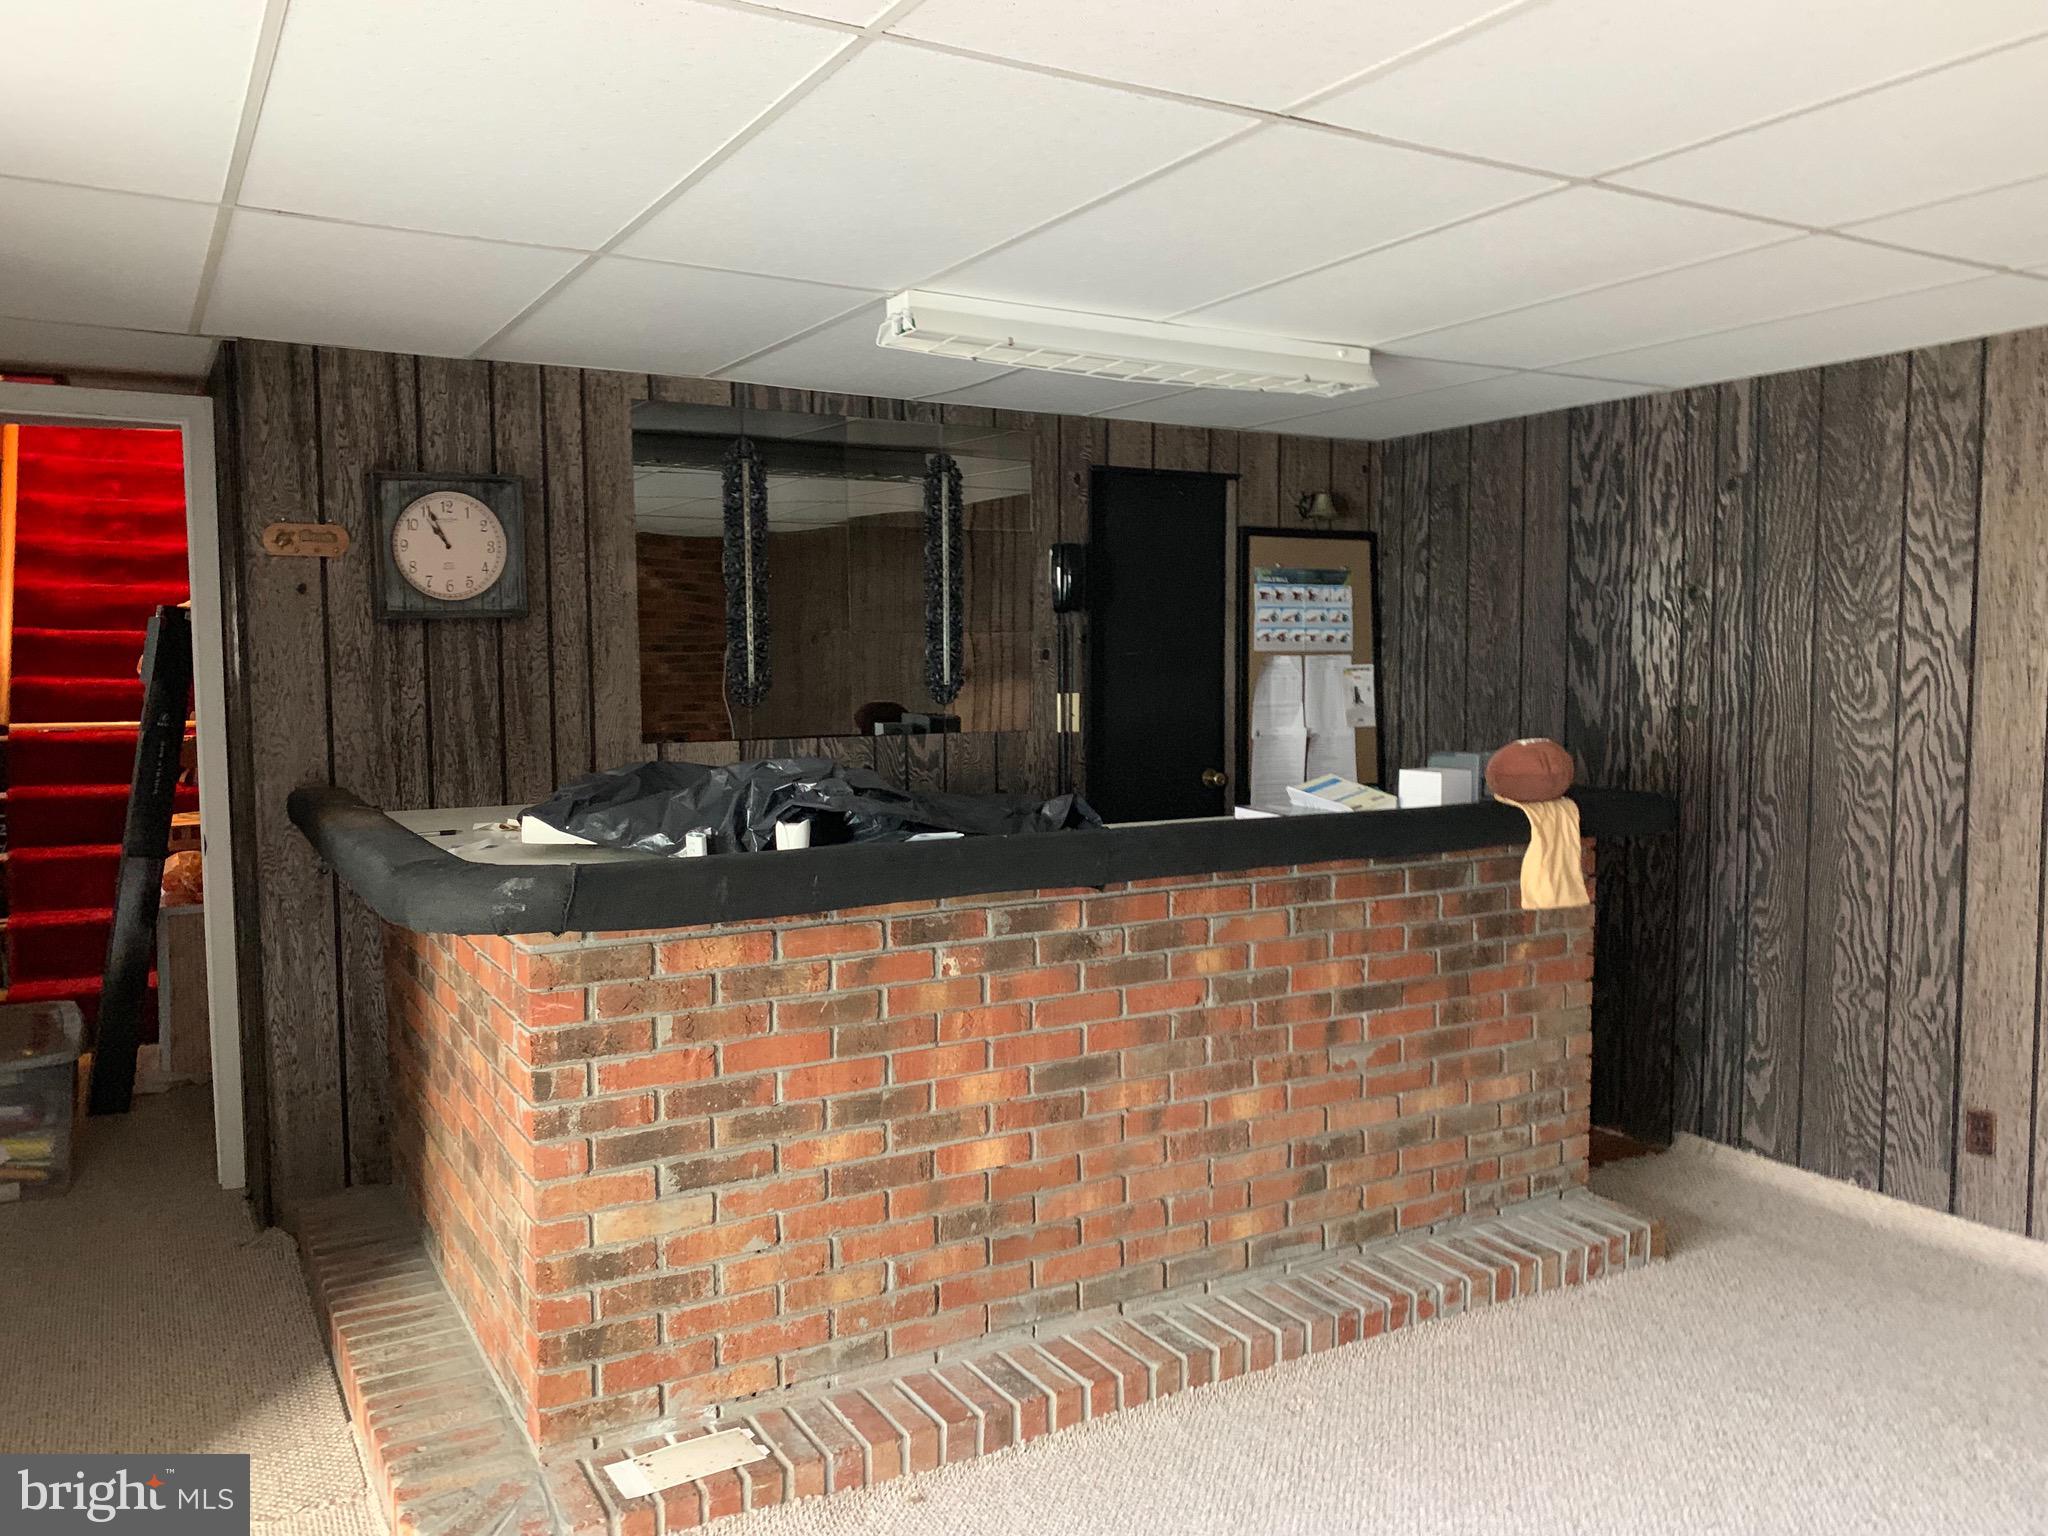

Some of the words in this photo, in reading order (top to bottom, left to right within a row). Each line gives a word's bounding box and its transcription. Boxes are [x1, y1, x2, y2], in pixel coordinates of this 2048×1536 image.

[441, 501, 453, 514] 12
[465, 506, 471, 519] 1
[406, 518, 419, 531] 10
[480, 520, 488, 532] 2
[400, 539, 409, 552] 9
[487, 541, 495, 553] 3
[409, 561, 417, 574] 8
[482, 562, 489, 574] 4
[425, 575, 433, 588] 7
[446, 580, 454, 592] 6
[466, 576, 474, 588] 5
